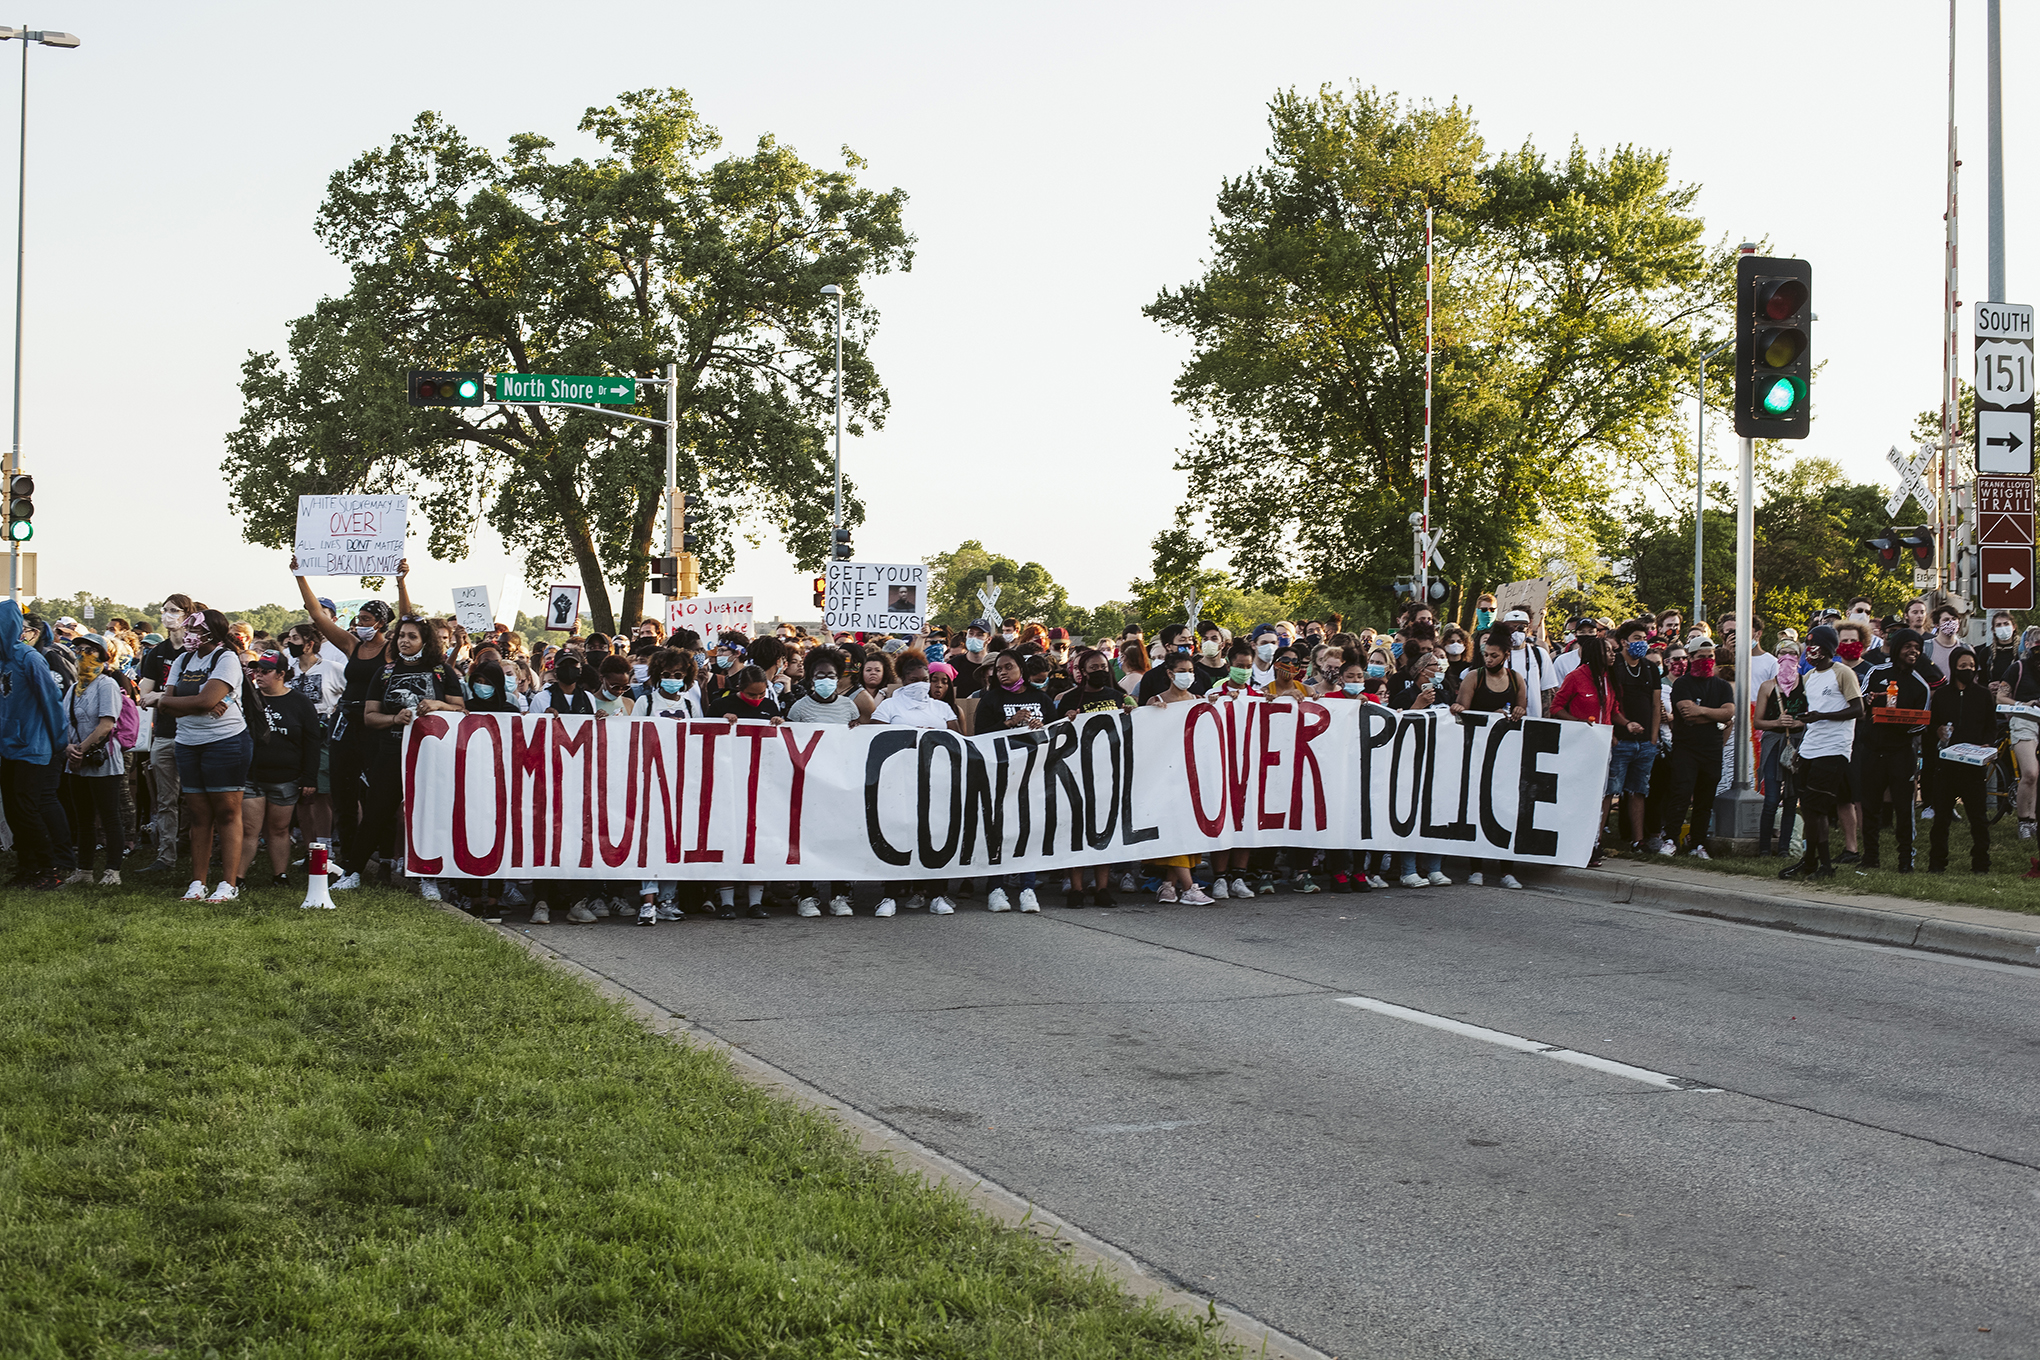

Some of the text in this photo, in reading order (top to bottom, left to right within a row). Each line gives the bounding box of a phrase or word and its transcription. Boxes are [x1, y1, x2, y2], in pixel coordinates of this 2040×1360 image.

[1979, 307, 2030, 332] SOUTH
[1984, 354, 2025, 393] 151
[504, 377, 607, 399] North Shore Dr
[1888, 444, 1933, 513] CROSSING
[2006, 481, 2030, 489] LLOYD
[1981, 488, 2030, 498] WRIGHT
[300, 497, 337, 517] WHITE
[1981, 498, 2031, 511] TRAIL
[330, 511, 382, 534] OVER!
[296, 539, 404, 551] ALL LIVES DONT MATTER
[377, 553, 402, 573] MATTE
[829, 565, 923, 583] GET YOUR
[462, 588, 476, 598] NO
[829, 581, 877, 596] KNEE
[671, 600, 753, 621] NO Justice
[828, 597, 864, 611] OFF
[825, 612, 924, 631] OUR NECKS!
[405, 700, 1562, 877] COMMUNITY CONTROL OVER POLICE
